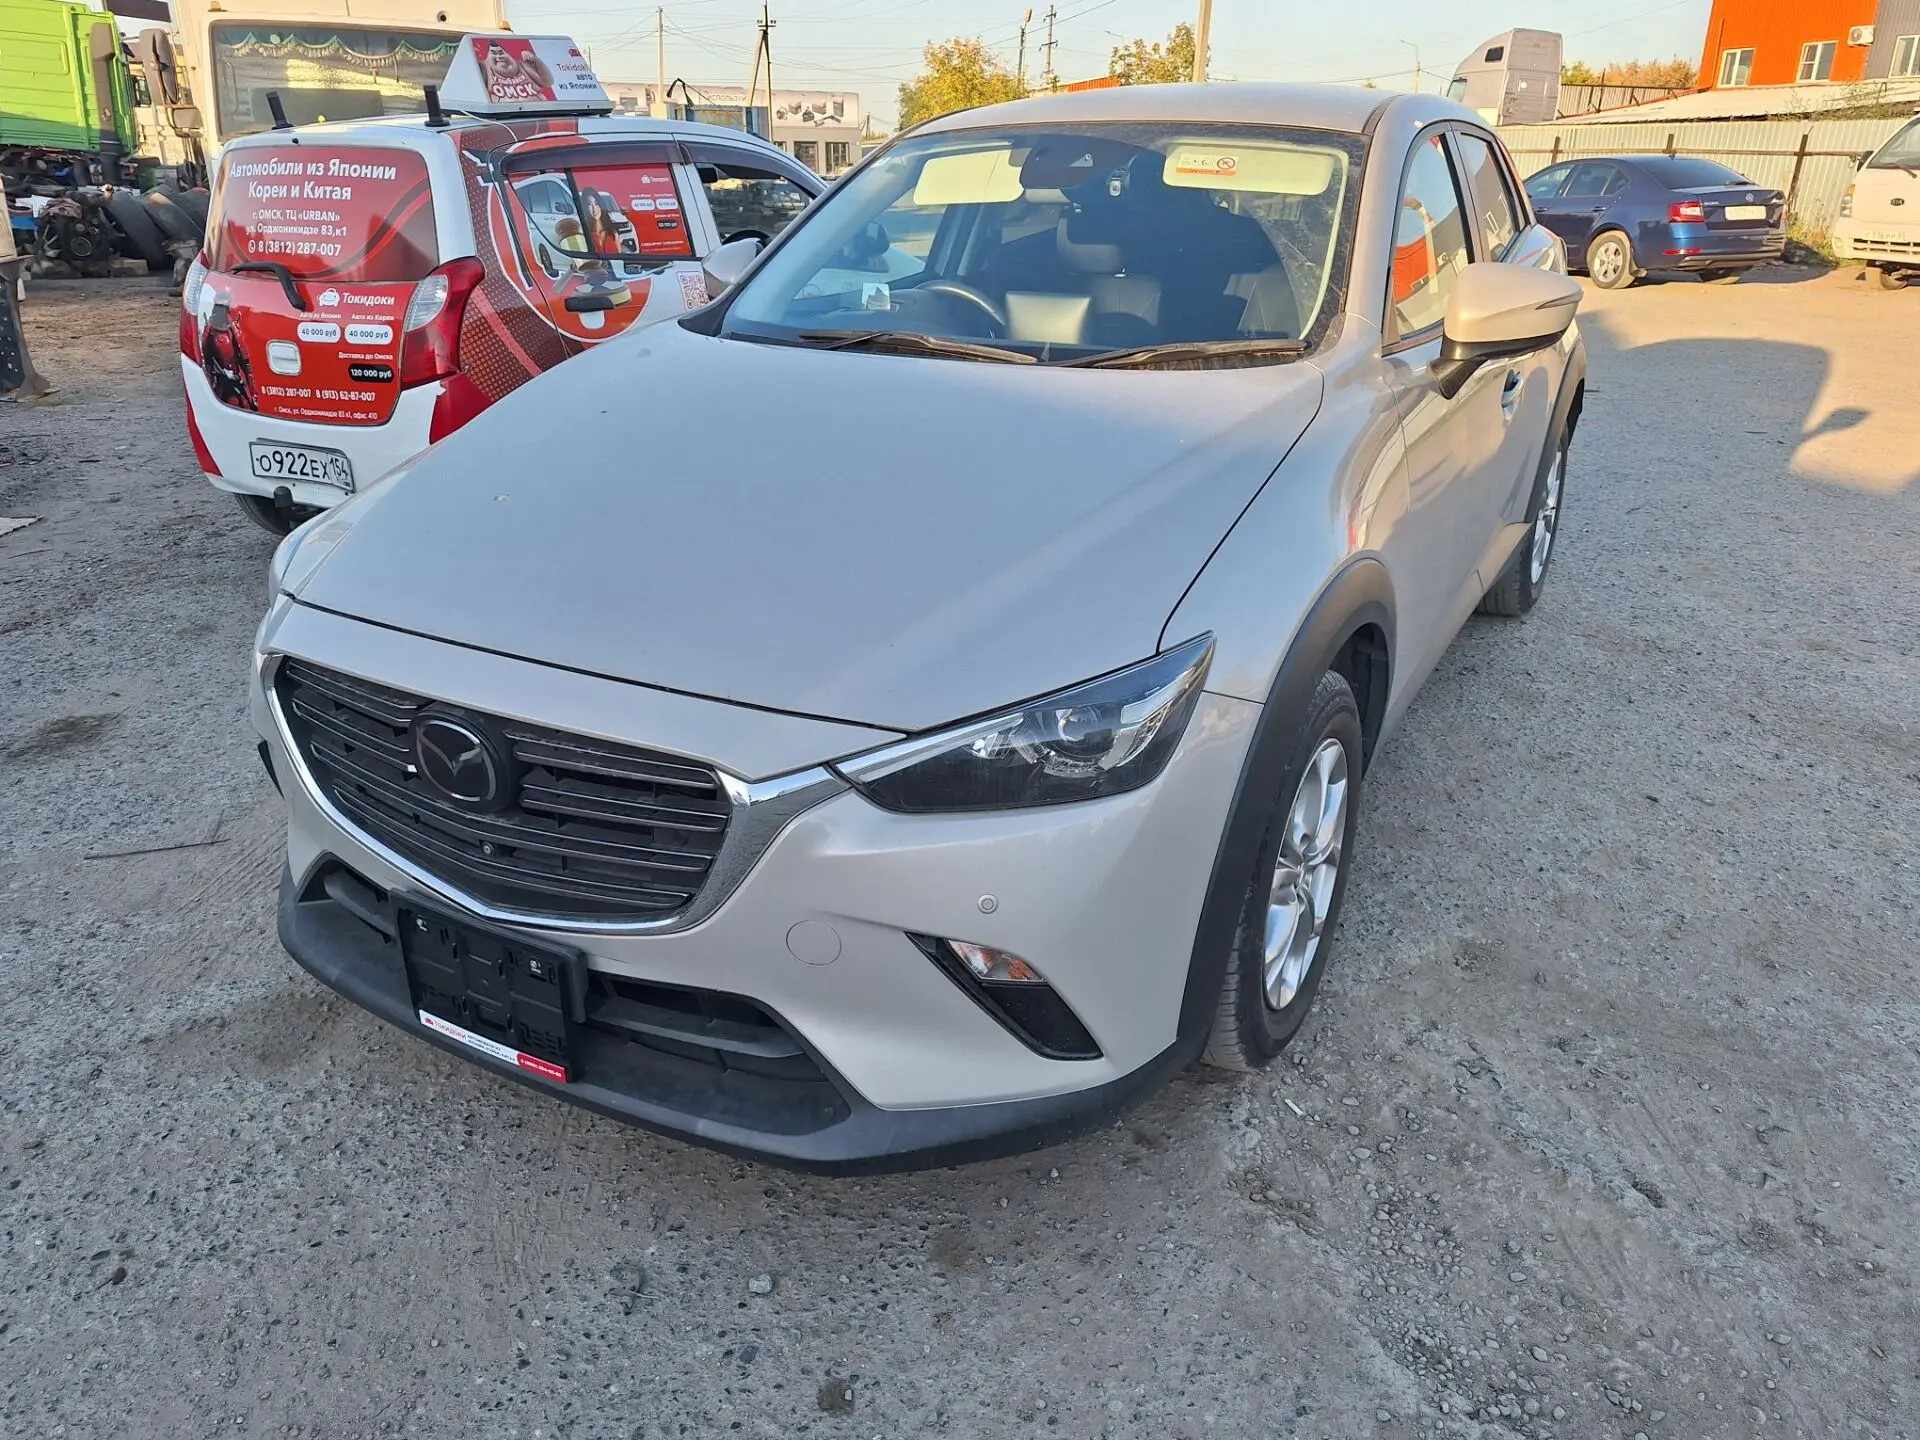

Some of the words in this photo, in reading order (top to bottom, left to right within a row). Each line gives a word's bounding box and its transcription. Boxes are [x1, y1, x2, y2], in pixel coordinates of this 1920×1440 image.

[493, 83, 537, 97] ОМСК
[230, 157, 303, 178] Автомобили
[307, 163, 324, 176] из
[327, 158, 397, 180] Японии
[248, 181, 288, 202] Кореи
[291, 185, 300, 198] и
[303, 181, 352, 200] Китая
[286, 209, 297, 221] ТЦ
[296, 242, 342, 257] 287-007
[343, 292, 395, 307] Токидоки
[301, 328, 310, 336] 40
[311, 328, 324, 337] 000
[325, 329, 337, 338] руб
[349, 330, 358, 338] 40
[359, 330, 374, 338] 000
[375, 330, 389, 339] руб
[350, 368, 362, 377] 120
[363, 369, 378, 378] 000
[378, 370, 393, 379] руб
